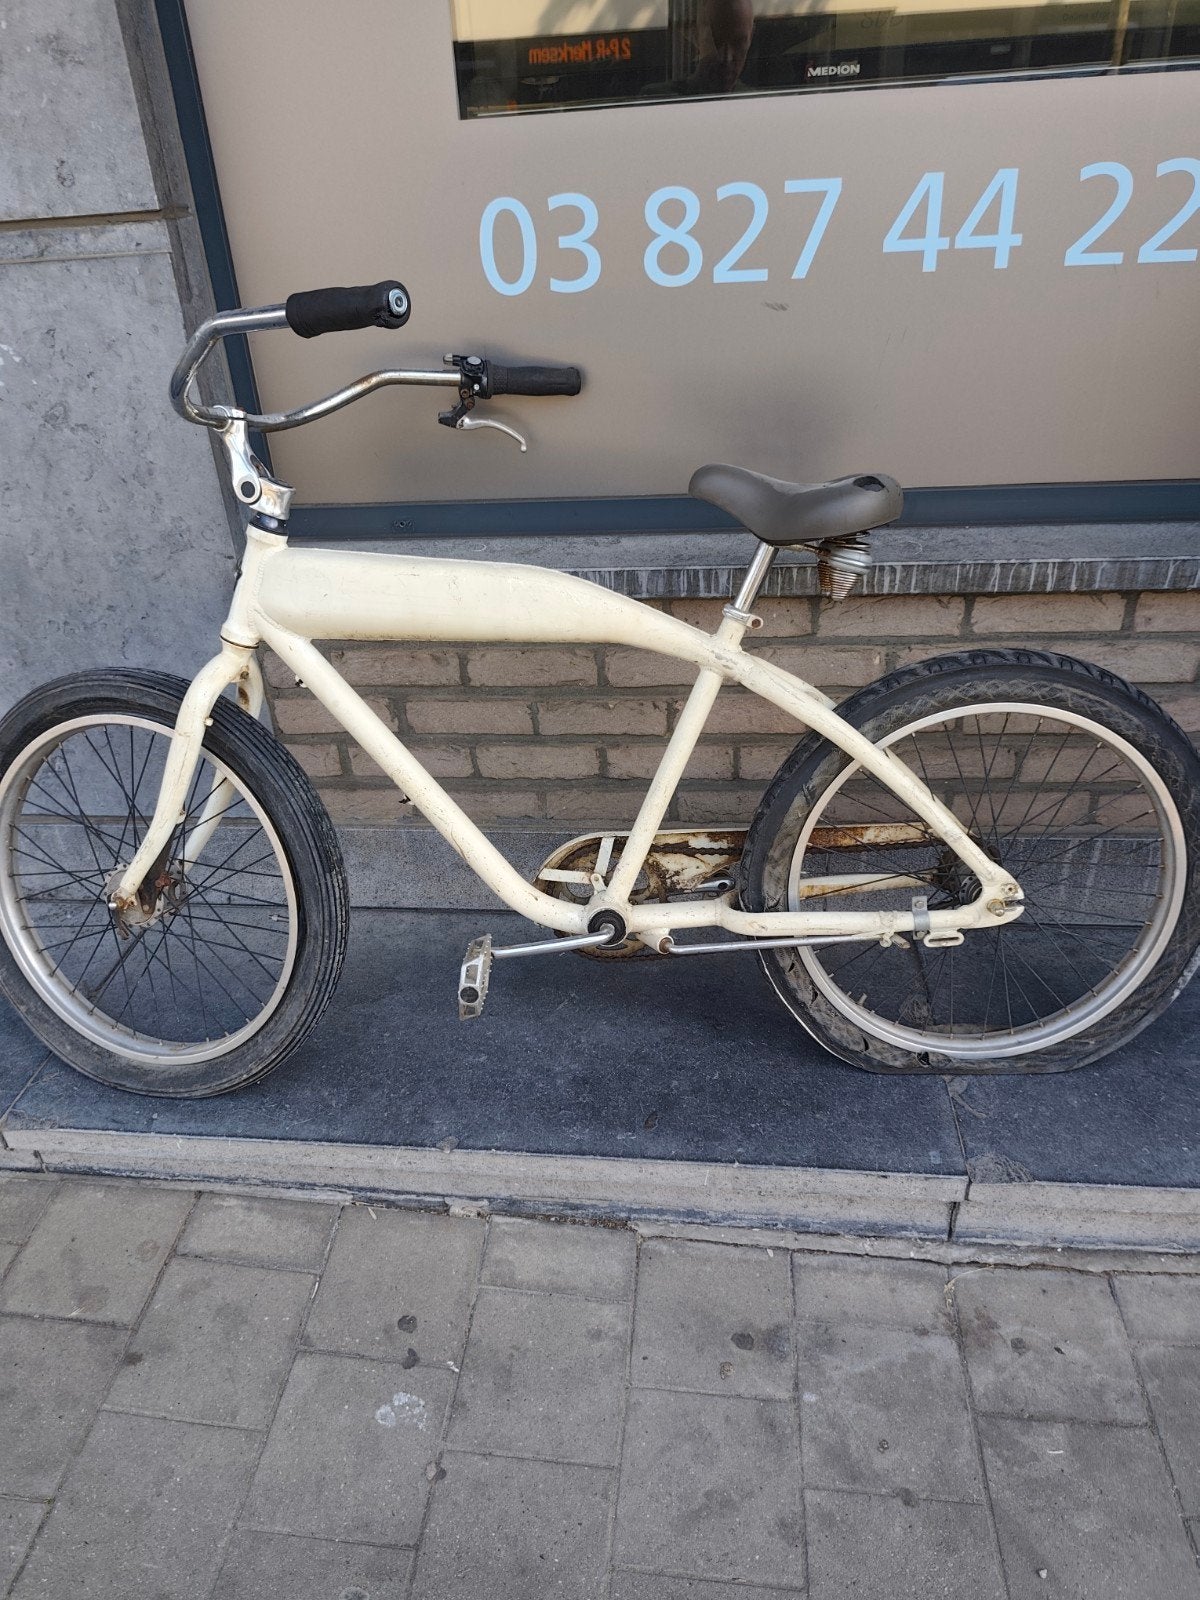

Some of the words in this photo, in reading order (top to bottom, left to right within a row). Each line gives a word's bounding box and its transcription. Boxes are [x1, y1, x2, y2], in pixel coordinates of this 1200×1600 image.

[807, 64, 860, 77] MEDION
[479, 192, 601, 297] 03
[643, 177, 843, 288] 827
[882, 168, 1023, 274] 44
[1064, 157, 1200, 268] 22
